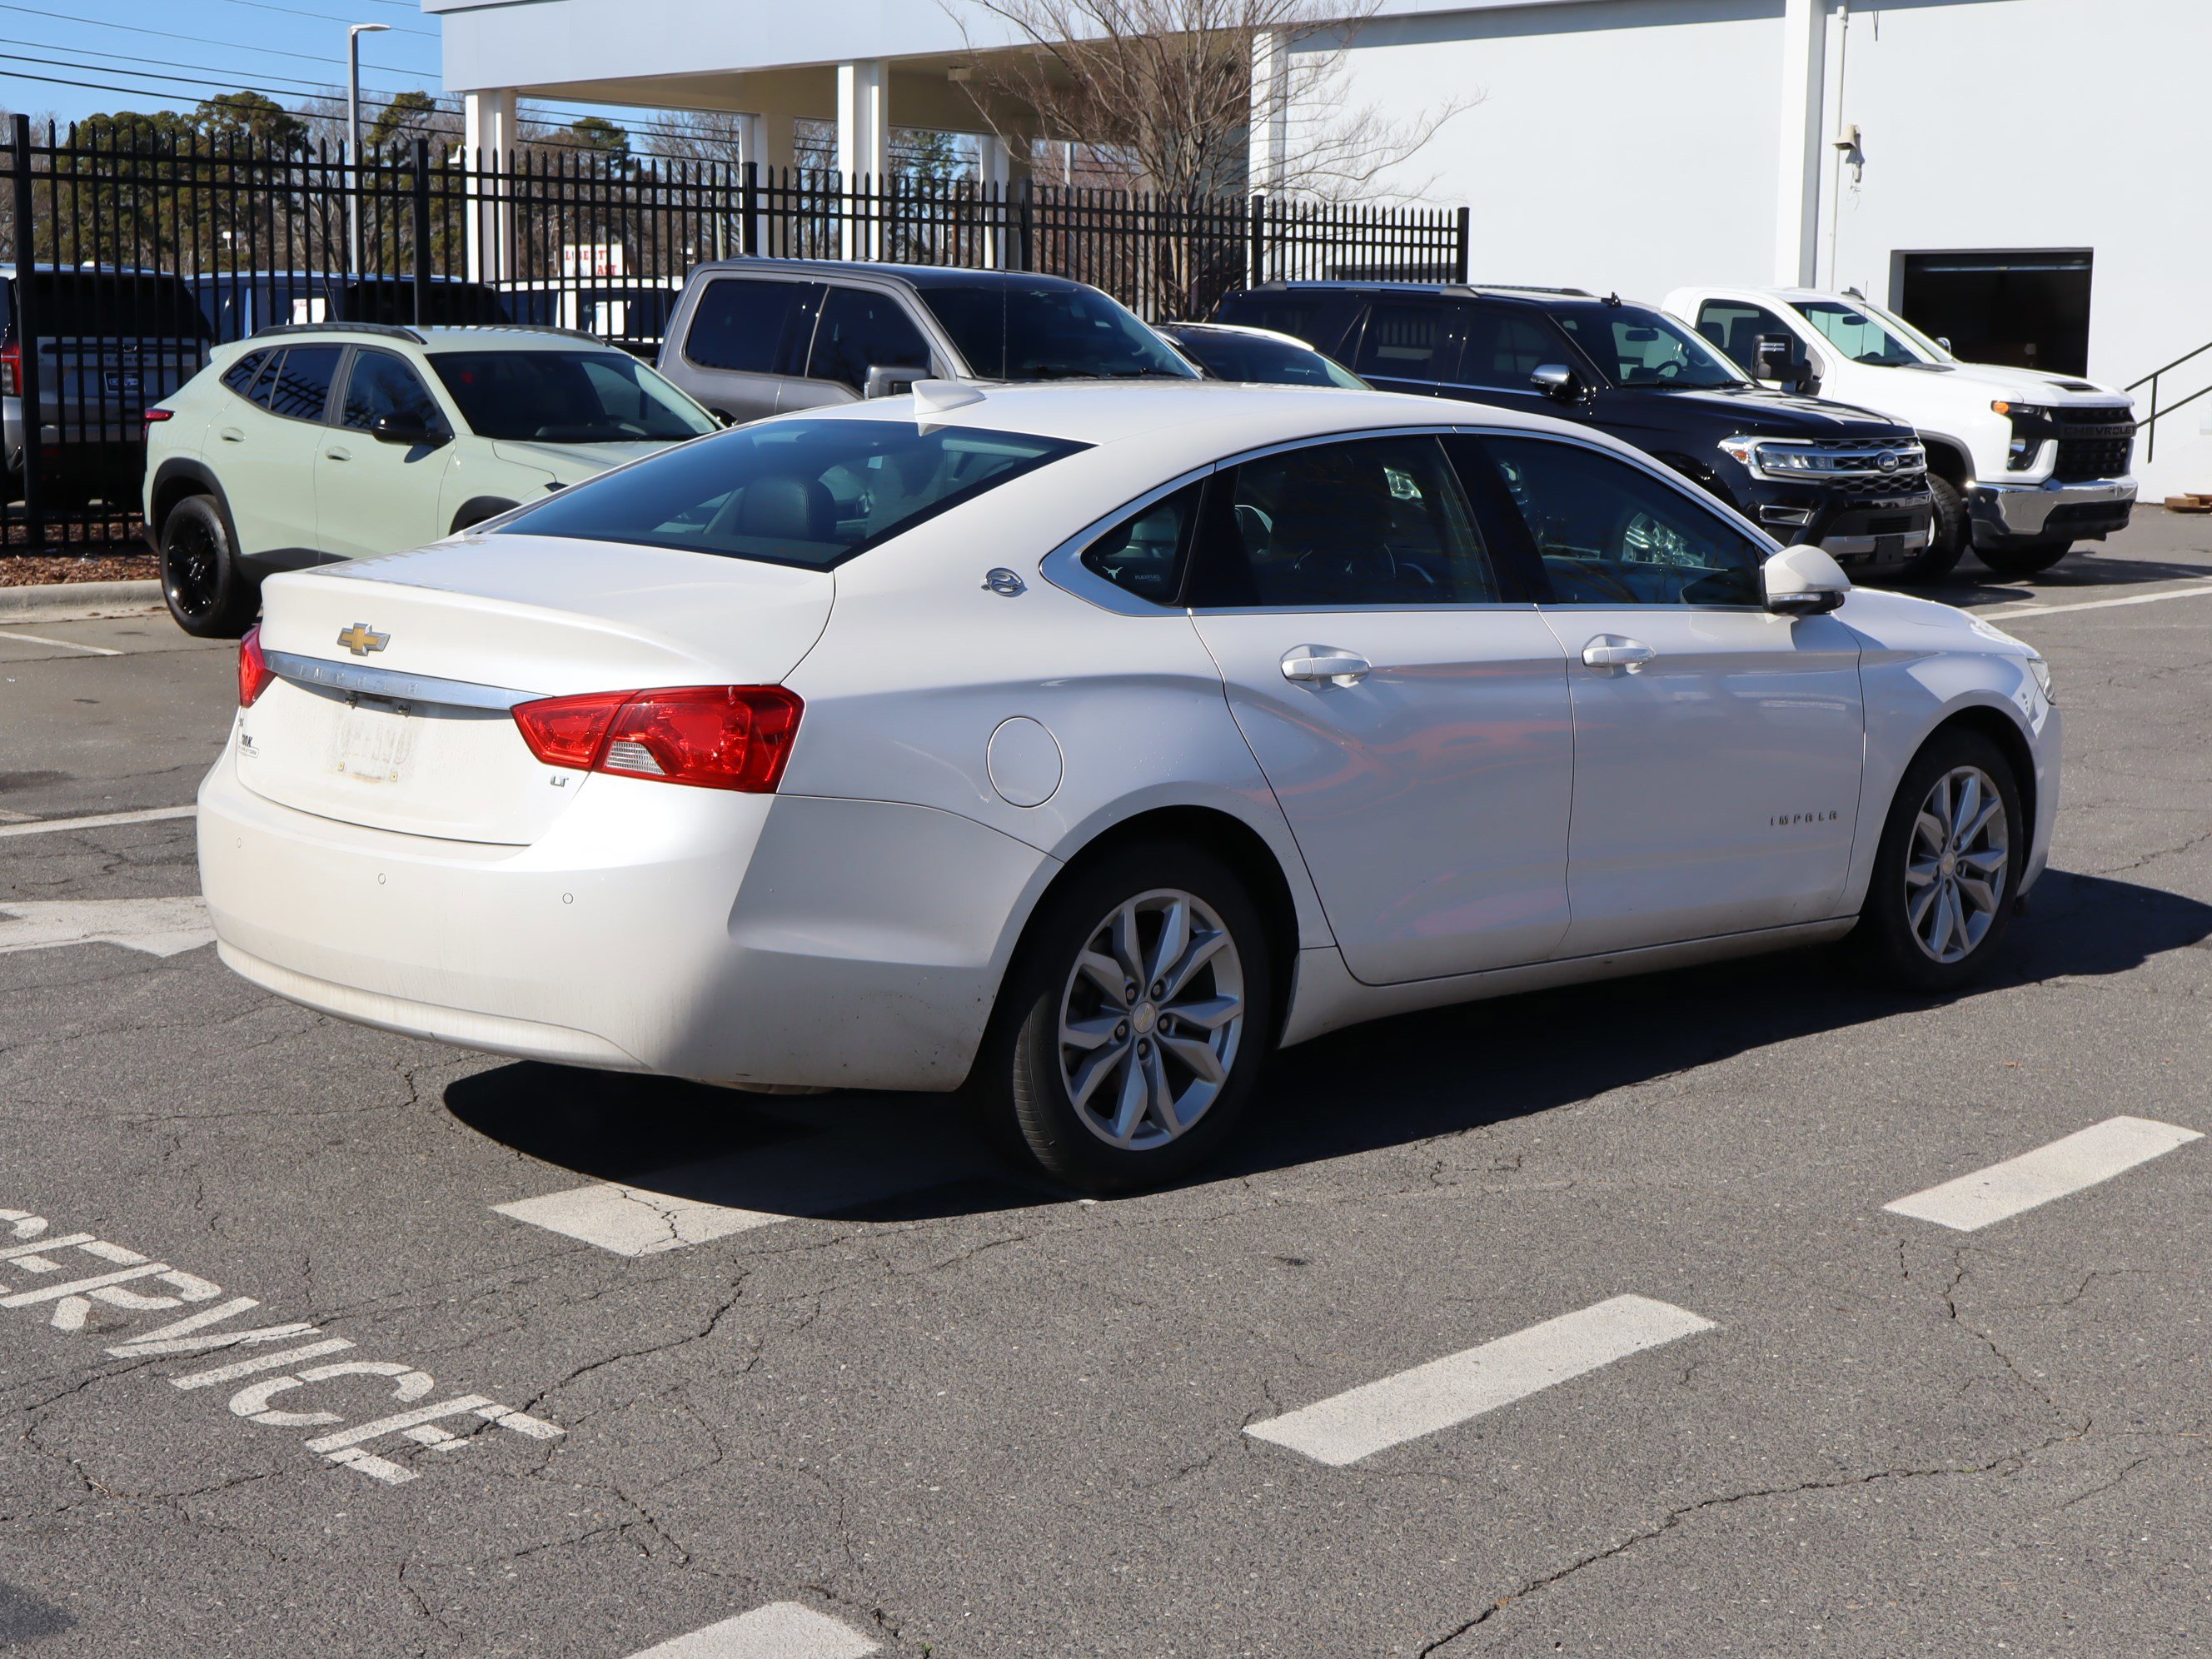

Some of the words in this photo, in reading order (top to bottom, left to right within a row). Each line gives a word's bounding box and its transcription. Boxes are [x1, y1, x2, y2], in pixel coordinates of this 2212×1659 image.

[2065, 426, 2136, 435] CHEVROLET
[298, 663, 421, 695] IMPALA
[550, 775, 570, 788] LT
[1770, 810, 1837, 827] IMPALA
